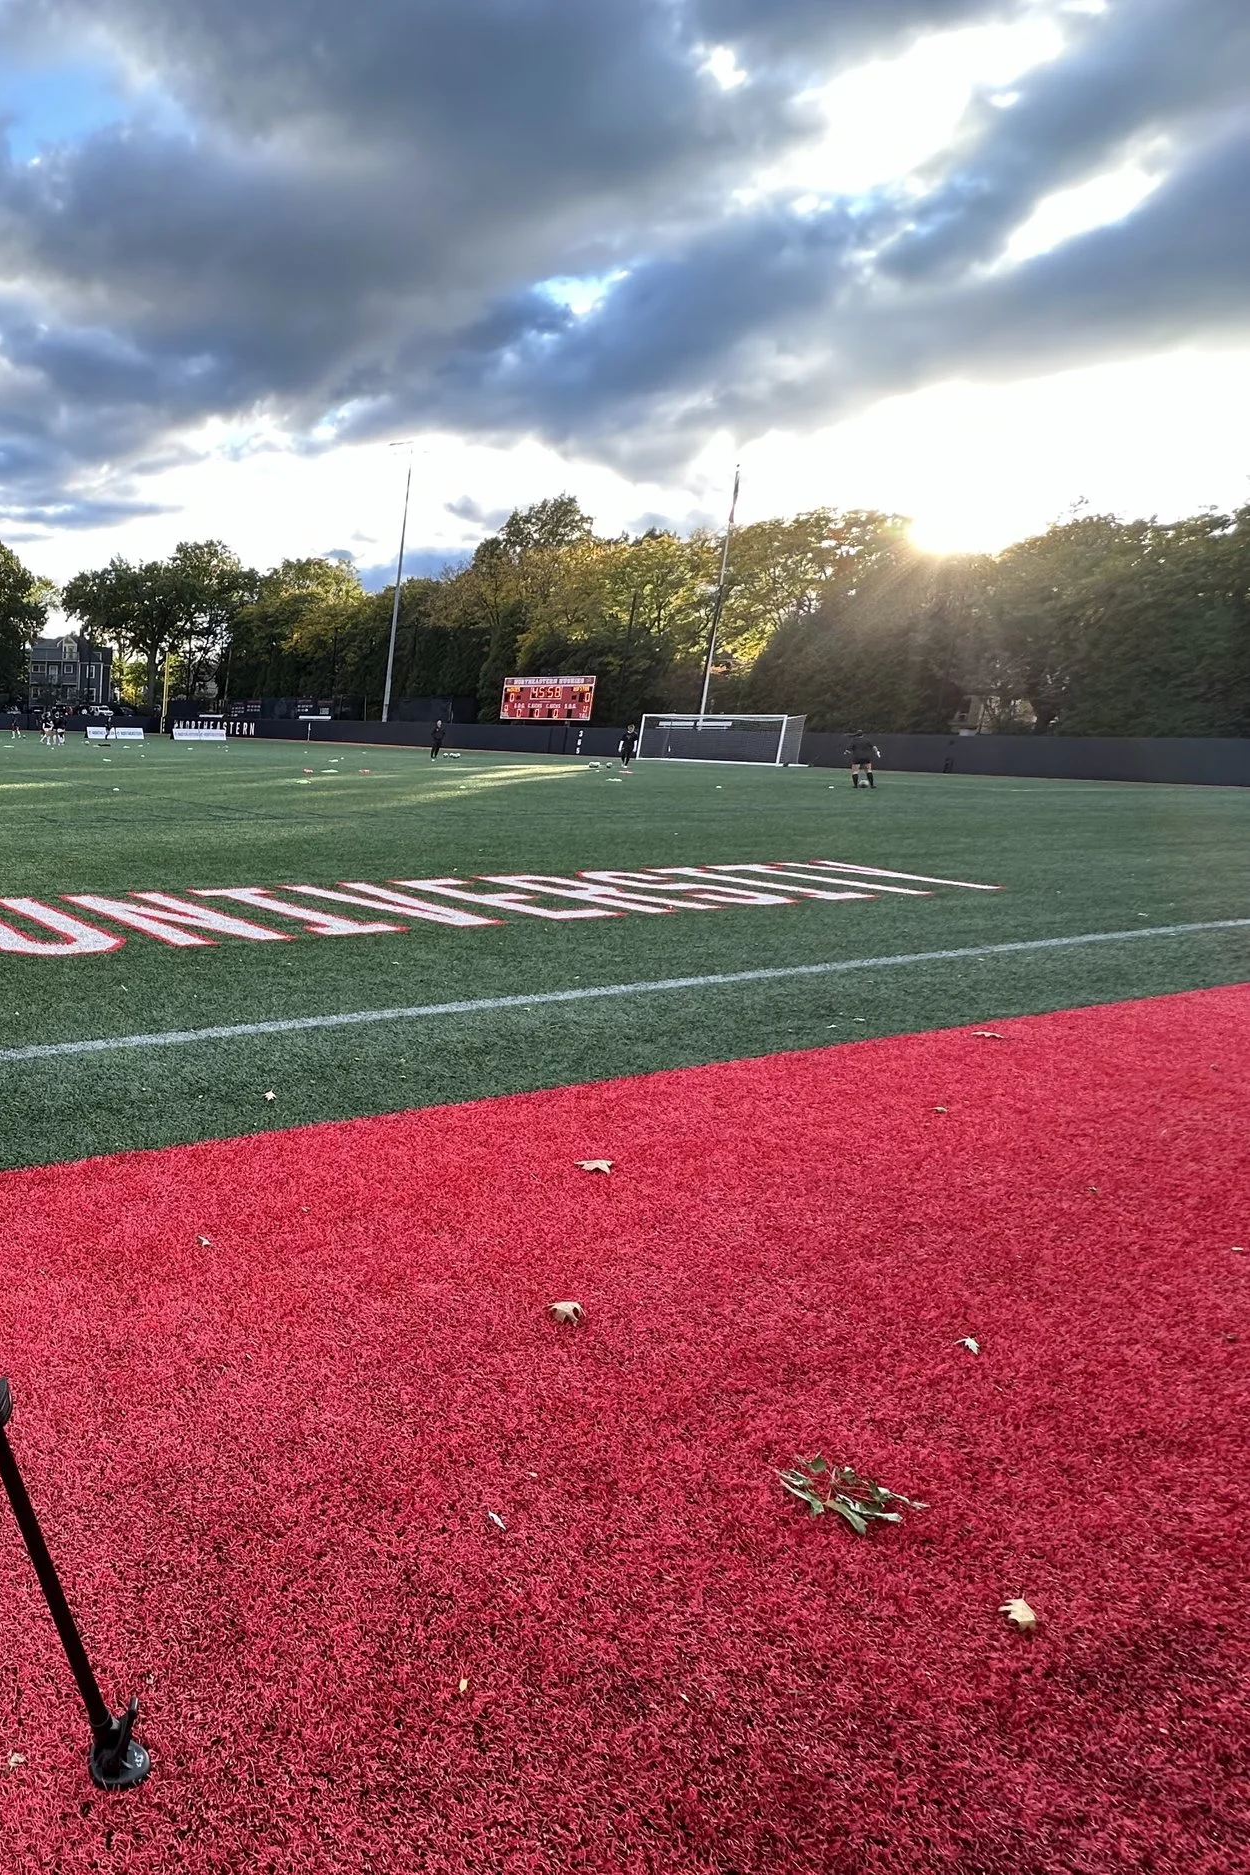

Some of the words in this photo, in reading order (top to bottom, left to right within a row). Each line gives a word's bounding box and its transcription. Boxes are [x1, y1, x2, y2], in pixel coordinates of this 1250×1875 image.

[533, 686, 561, 698] 45:58
[509, 693, 515, 702] 0
[585, 693, 590, 703] 0
[534, 708, 540, 718] 0
[553, 708, 559, 718] 0
